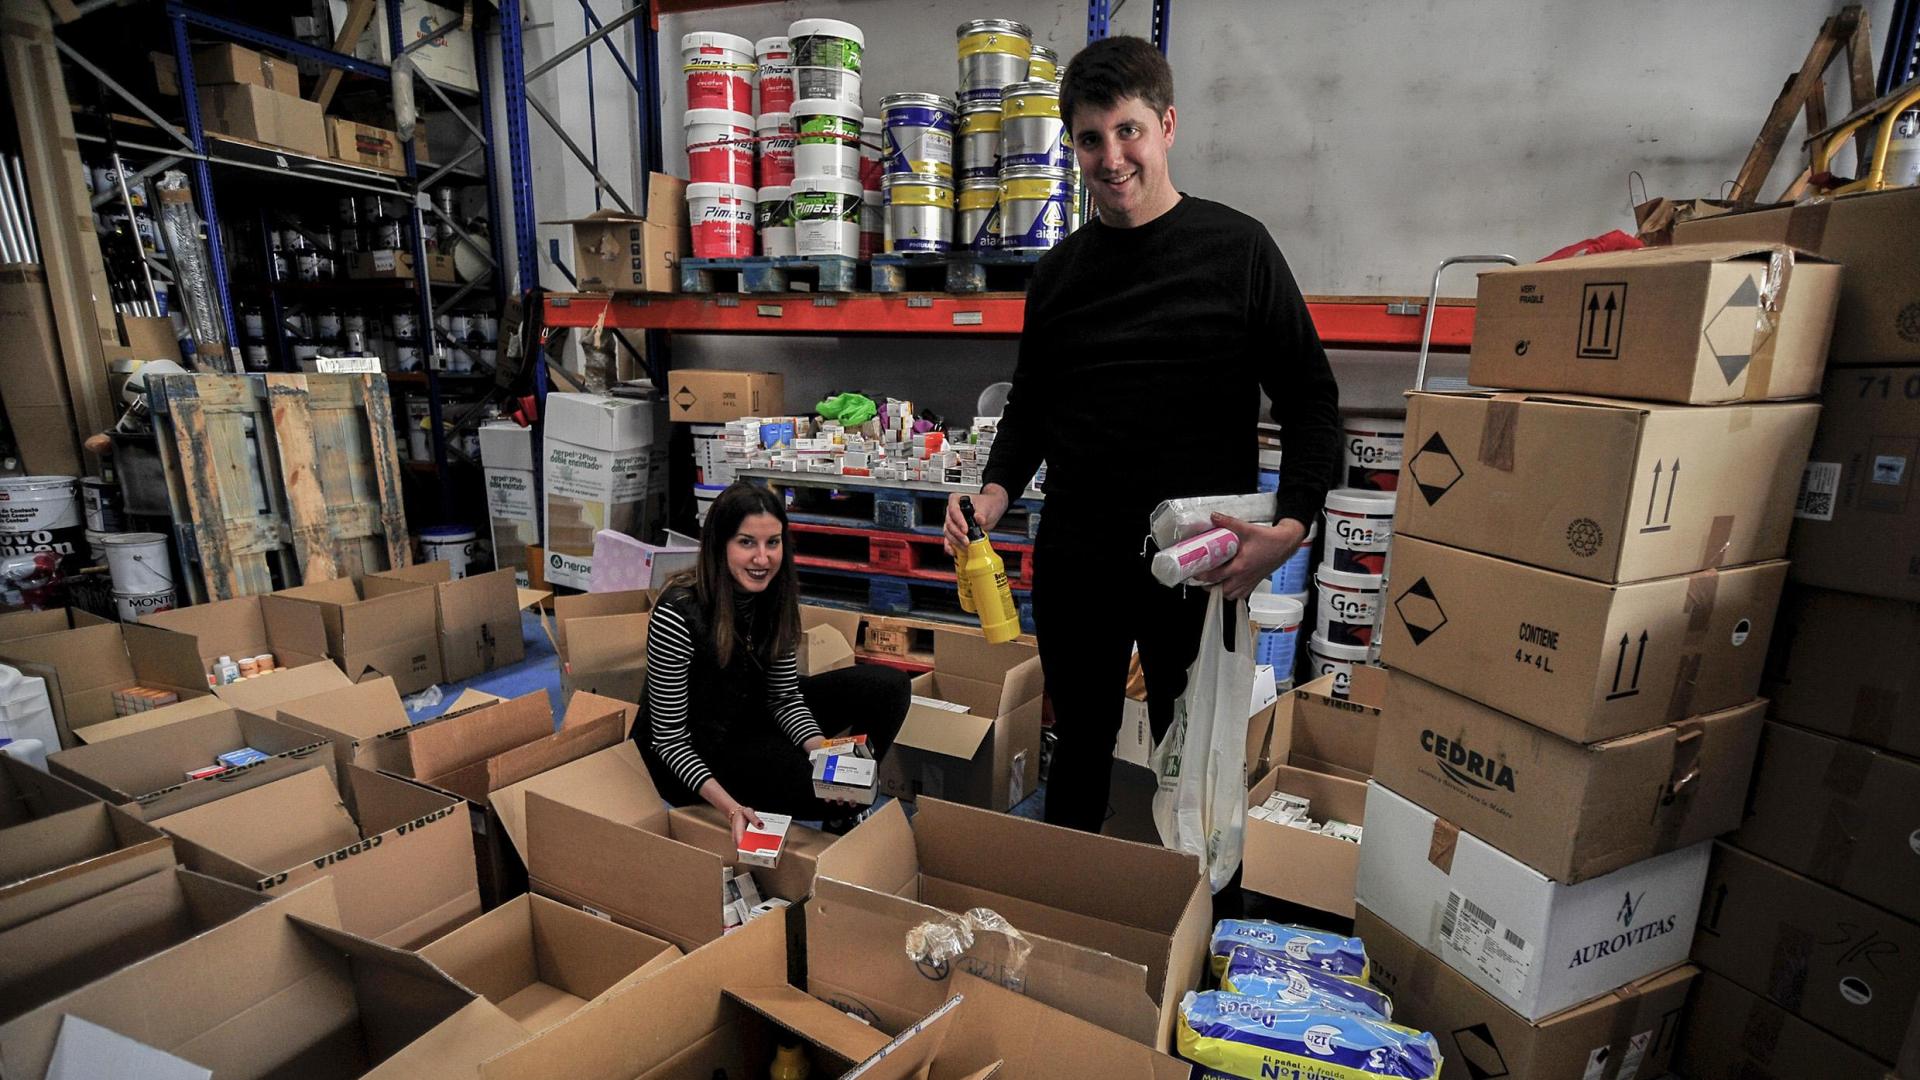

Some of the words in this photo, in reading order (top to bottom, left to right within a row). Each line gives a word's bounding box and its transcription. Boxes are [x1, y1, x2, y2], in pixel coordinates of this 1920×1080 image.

[705, 206, 752, 221] Pimasa
[796, 202, 841, 215] Pimasa
[563, 560, 592, 574] nerpe
[1519, 622, 1560, 651] CONTIENE
[1420, 729, 1516, 793] CEDRIA
[313, 835, 384, 869] CEDRIA
[1568, 914, 1677, 969] AUROVITAS
[1307, 1033, 1328, 1047] 12h
[1275, 1059, 1300, 1069] pañal
